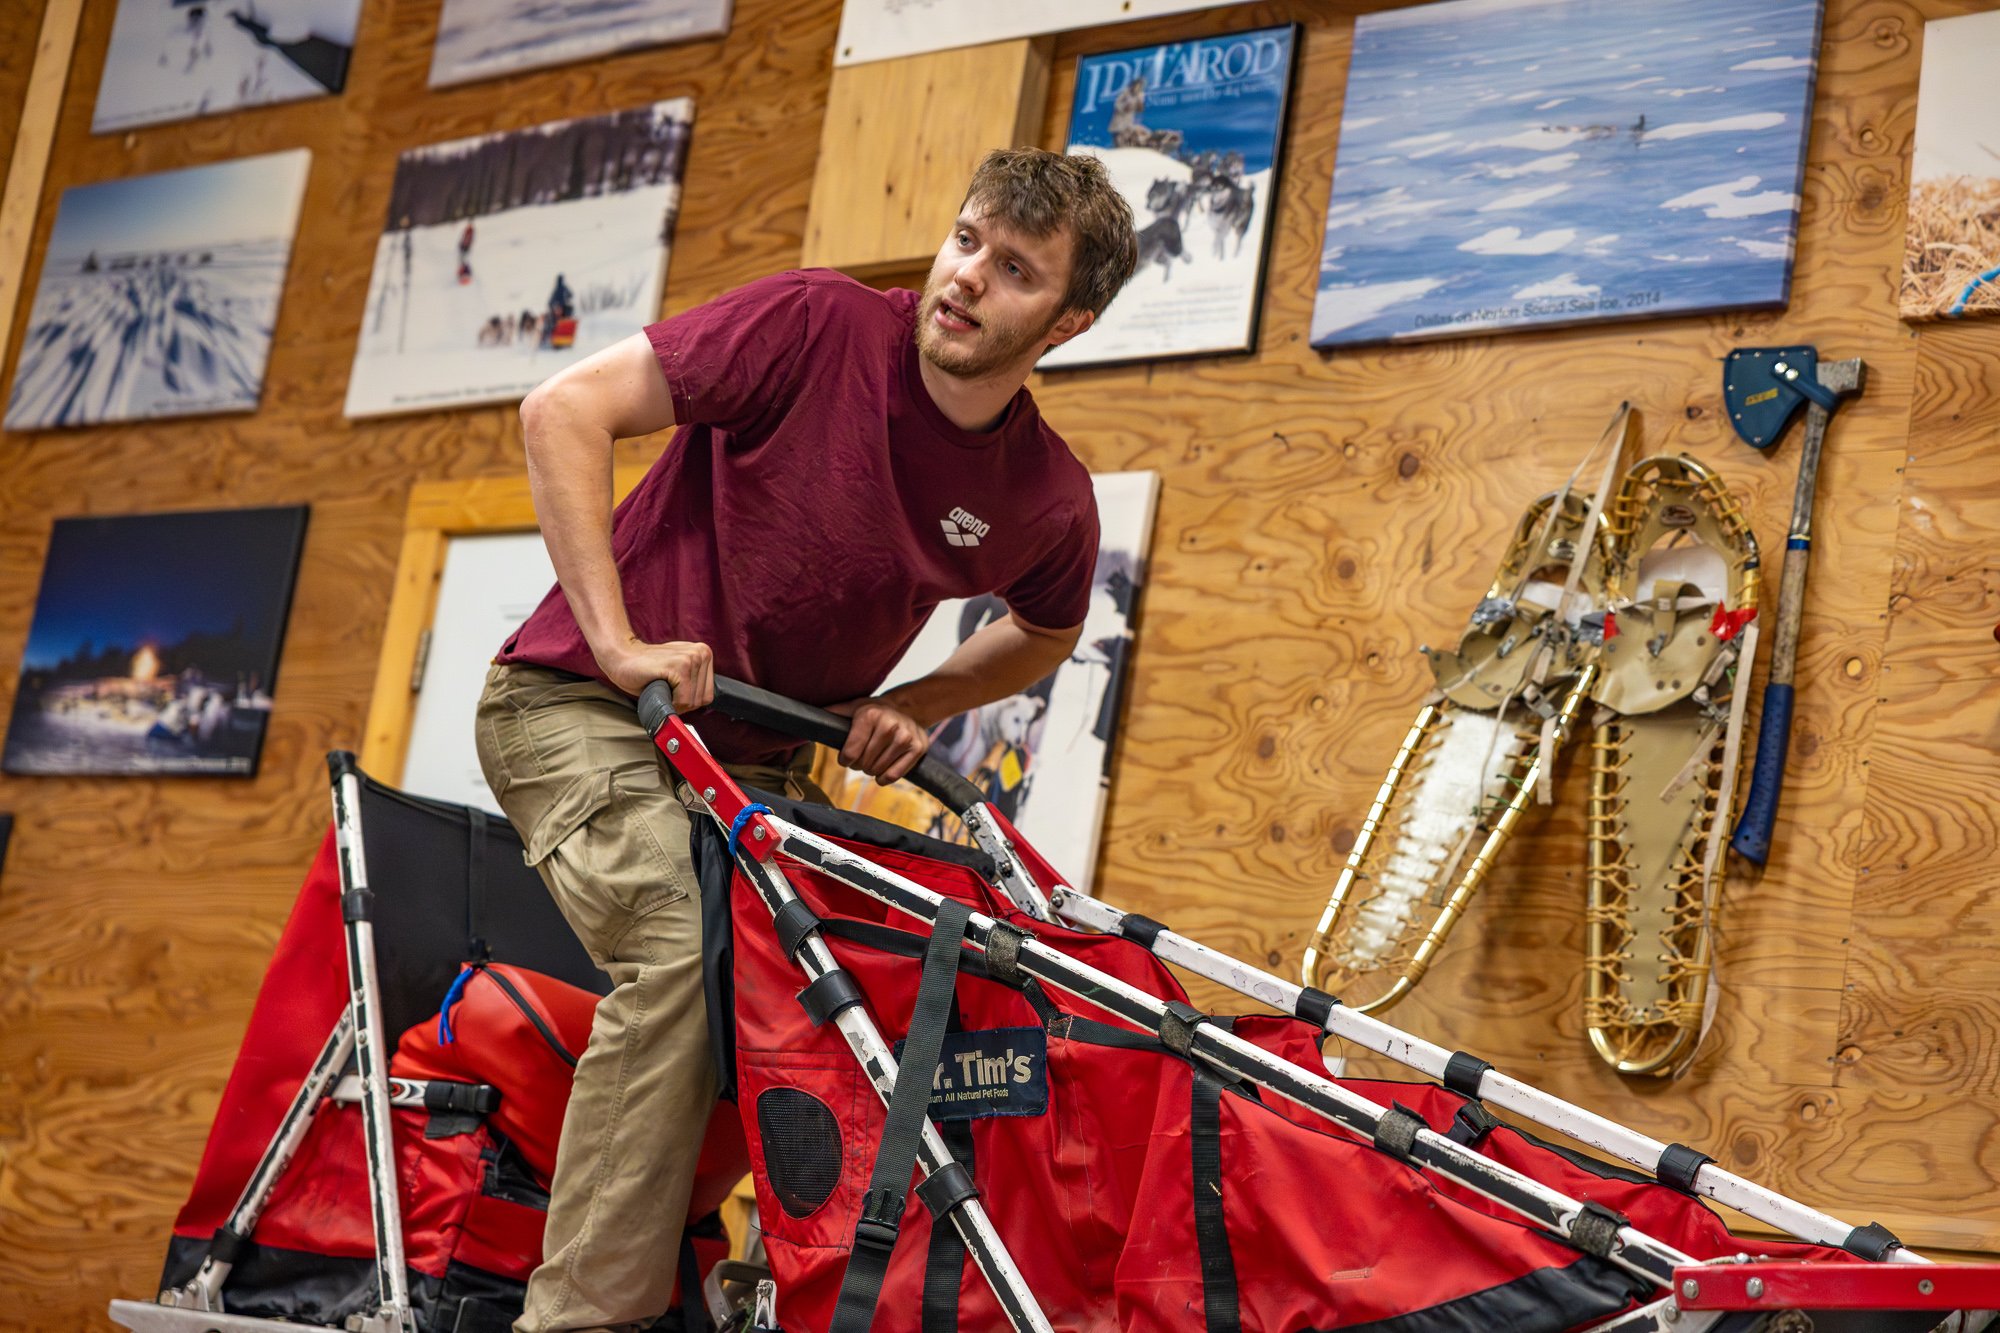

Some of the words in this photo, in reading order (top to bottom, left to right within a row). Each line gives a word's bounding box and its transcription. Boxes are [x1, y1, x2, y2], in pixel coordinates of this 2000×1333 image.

[1414, 313, 1452, 328] Dallas
[1474, 307, 1520, 322] Norton
[1523, 301, 1565, 317] Sound
[1568, 299, 1595, 312] Sea
[1627, 291, 1661, 307] 2014
[948, 506, 991, 538] arena
[932, 1062, 953, 1090] r.
[954, 1048, 1033, 1087] Tim's
[945, 1092, 955, 1102] All
[957, 1090, 981, 1101] Natural
[982, 1088, 993, 1099] Pet
[993, 1087, 1009, 1098] Foods
